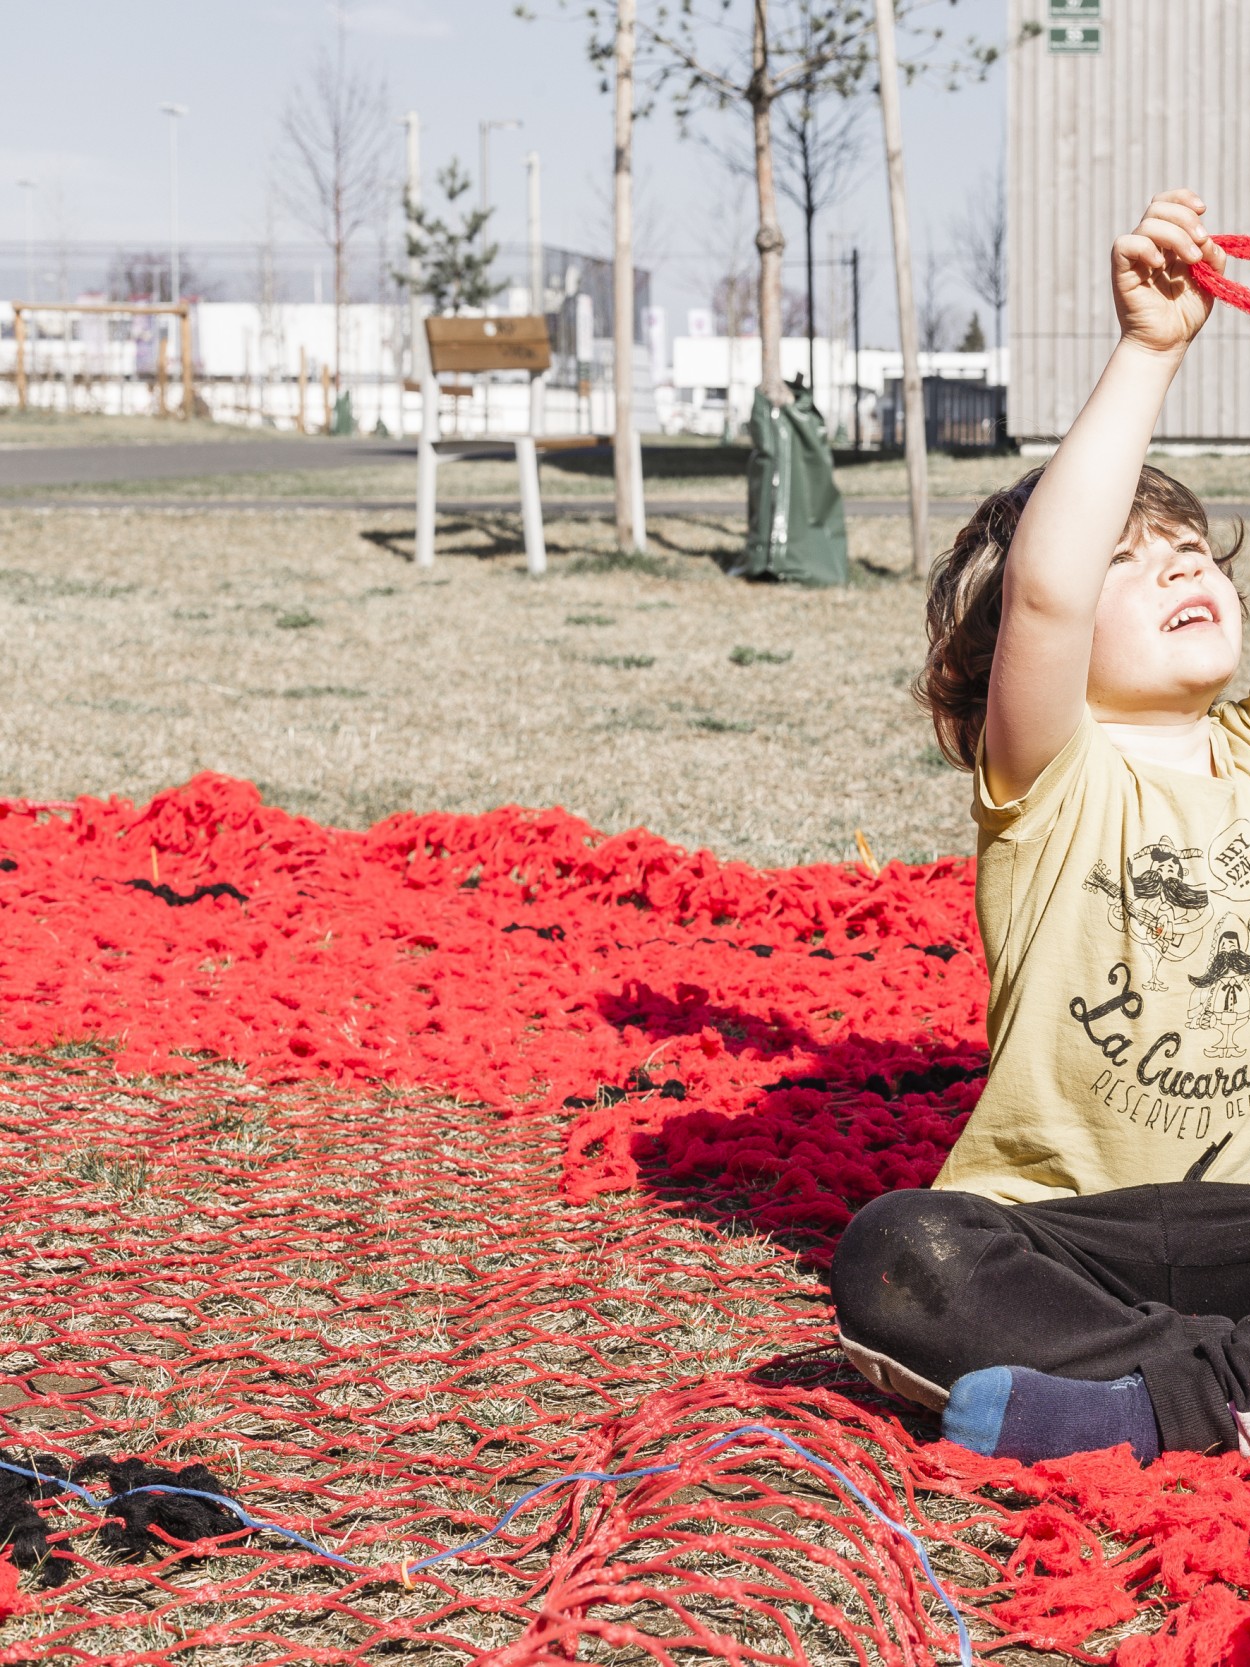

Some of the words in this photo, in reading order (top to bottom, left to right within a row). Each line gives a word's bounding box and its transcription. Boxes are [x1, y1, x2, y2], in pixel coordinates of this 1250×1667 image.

[1214, 833, 1250, 867] HEY
[1069, 962, 1144, 1067] La
[1090, 1069, 1211, 1140] RESERVED
